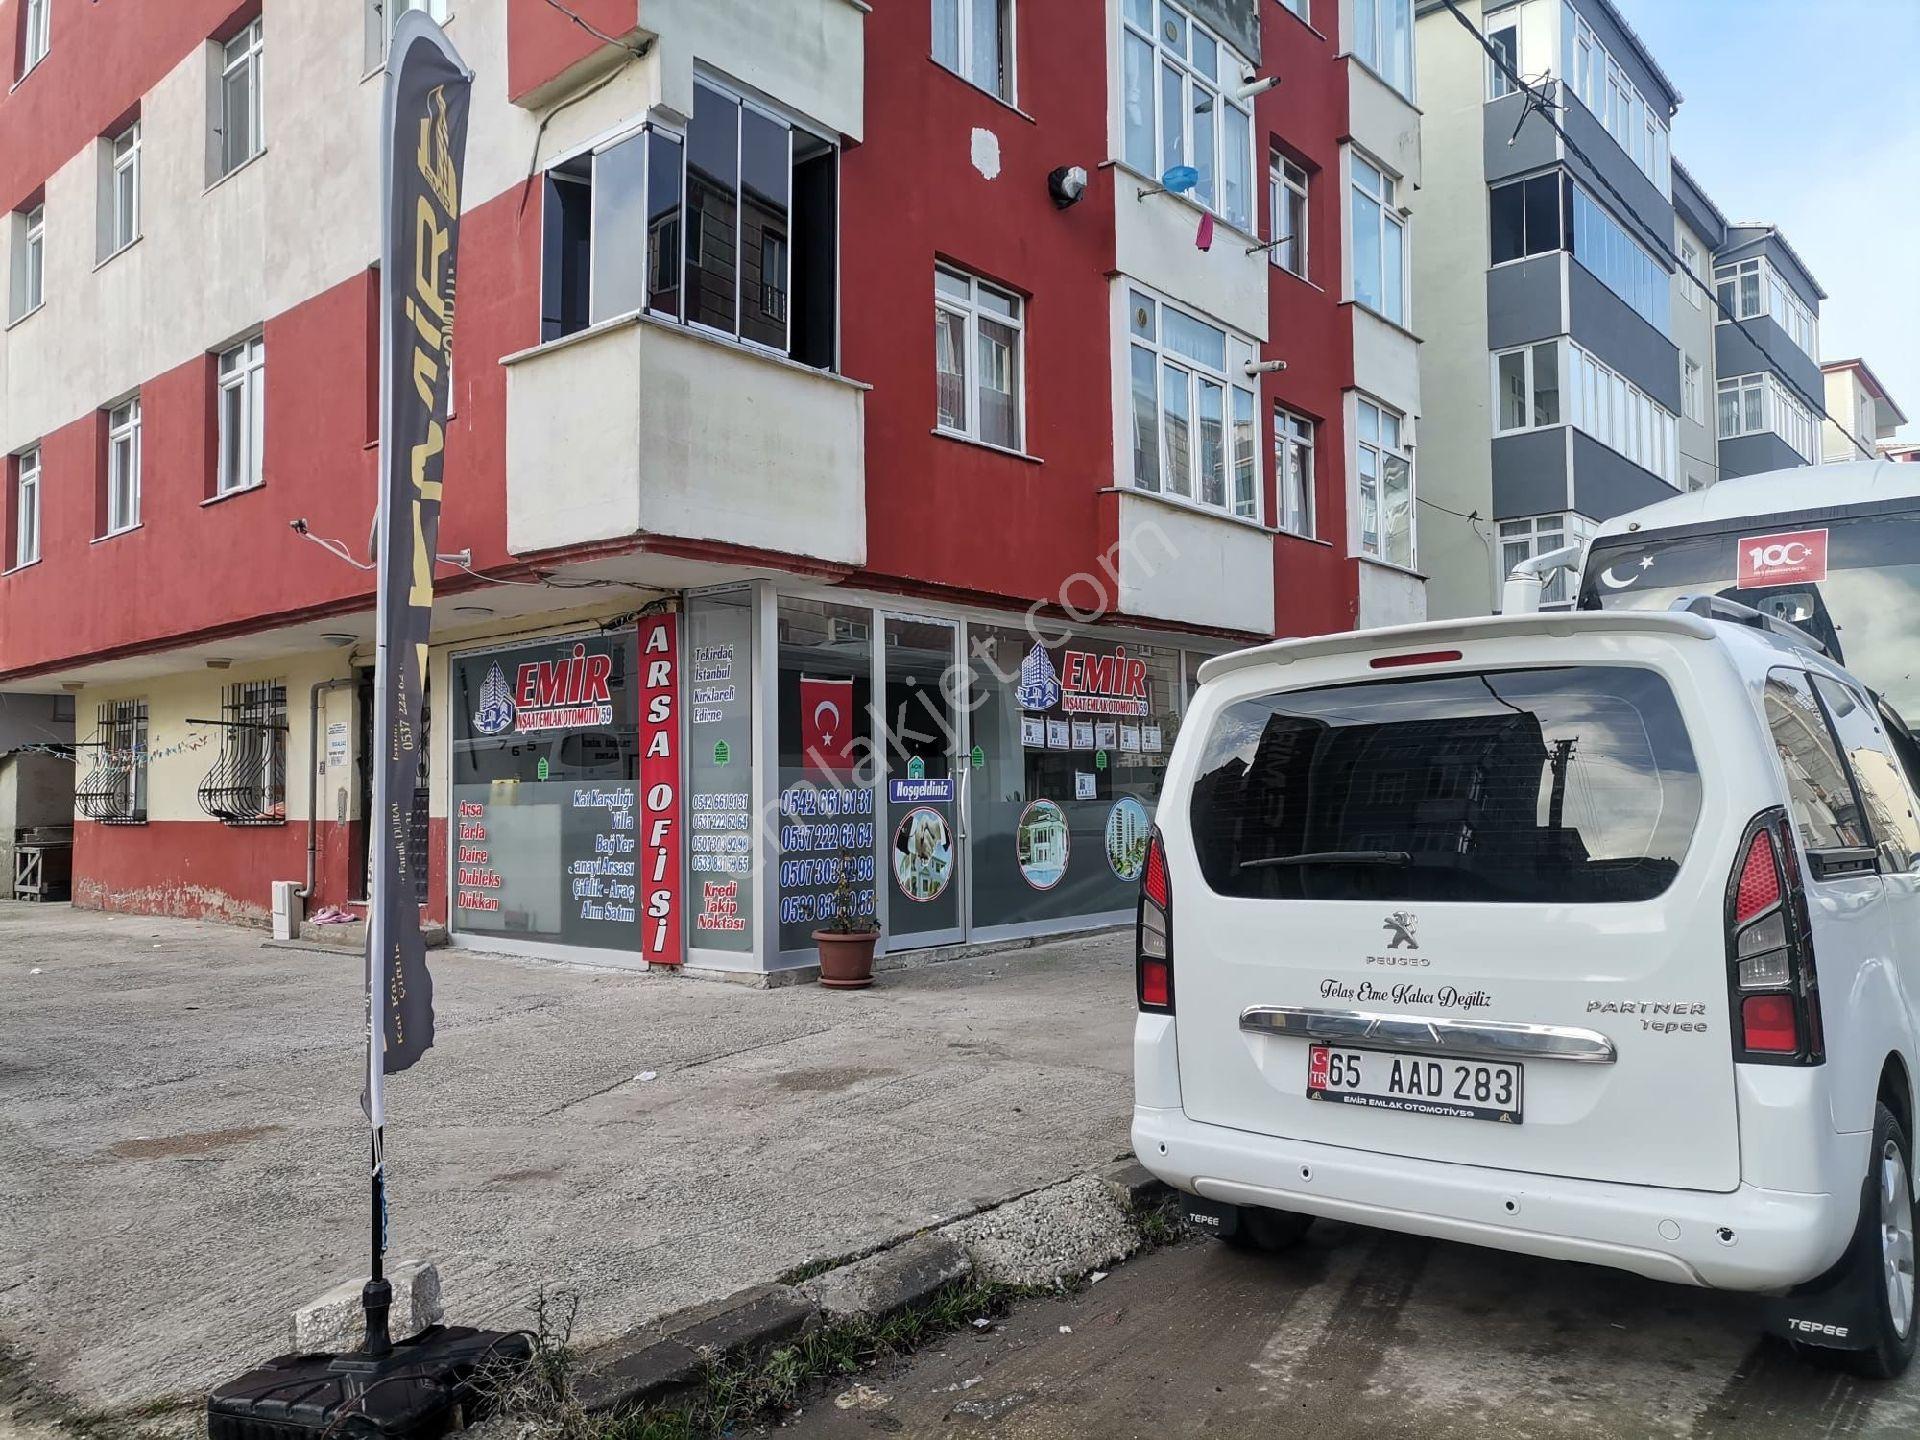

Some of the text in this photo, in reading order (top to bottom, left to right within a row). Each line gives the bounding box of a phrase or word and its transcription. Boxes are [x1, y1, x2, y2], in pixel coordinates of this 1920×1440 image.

[515, 643, 612, 708] EMİR
[694, 663, 731, 682] İstanbul
[1061, 646, 1147, 698] EMİR
[1062, 691, 1148, 717] İNŞAAT EMLAK OTOMOTİV 59
[562, 702, 600, 728] OTOMOTİV
[600, 705, 612, 725] 59
[693, 707, 722, 723] Edirne
[645, 625, 673, 953] ARSA OFİSİ
[458, 800, 483, 818] Arsa
[573, 788, 634, 811] Kat Karşılığı
[781, 788, 872, 816] 0542 661 91 31
[611, 811, 633, 830] Villa
[458, 822, 486, 841] Tarla
[814, 823, 838, 851] 222
[840, 823, 855, 848] 62
[857, 822, 873, 849] 64
[595, 834, 634, 855] Bağ Yer
[458, 846, 488, 863] Daire
[601, 857, 635, 876] Arsası
[780, 859, 814, 888] 0507
[814, 858, 839, 884] 303
[857, 855, 874, 882] 98
[458, 868, 501, 888] Dubleks
[573, 878, 603, 901] Çiftlik
[609, 880, 635, 902] Araç
[704, 881, 737, 897] Kredi
[458, 891, 499, 911] Dükkan
[704, 898, 738, 915] Takip
[857, 889, 875, 916] 65
[581, 900, 635, 922] Alım Satım
[697, 914, 745, 930] Noktası
[1366, 956, 1431, 967] PEUGEO
[1320, 978, 1491, 1011] Telaş Etme Kalıcı Değiliz
[1586, 1000, 1706, 1015] PARTNER
[1640, 1019, 1708, 1034] Tepee
[1311, 1070, 1326, 1084] TR
[1329, 1053, 1513, 1104] 65 AAD 283
[1343, 1095, 1367, 1105] EMİR
[1368, 1099, 1403, 1109] EMLAK
[1189, 1213, 1220, 1226] TEPEE
[1788, 1318, 1848, 1337] TEPEE
